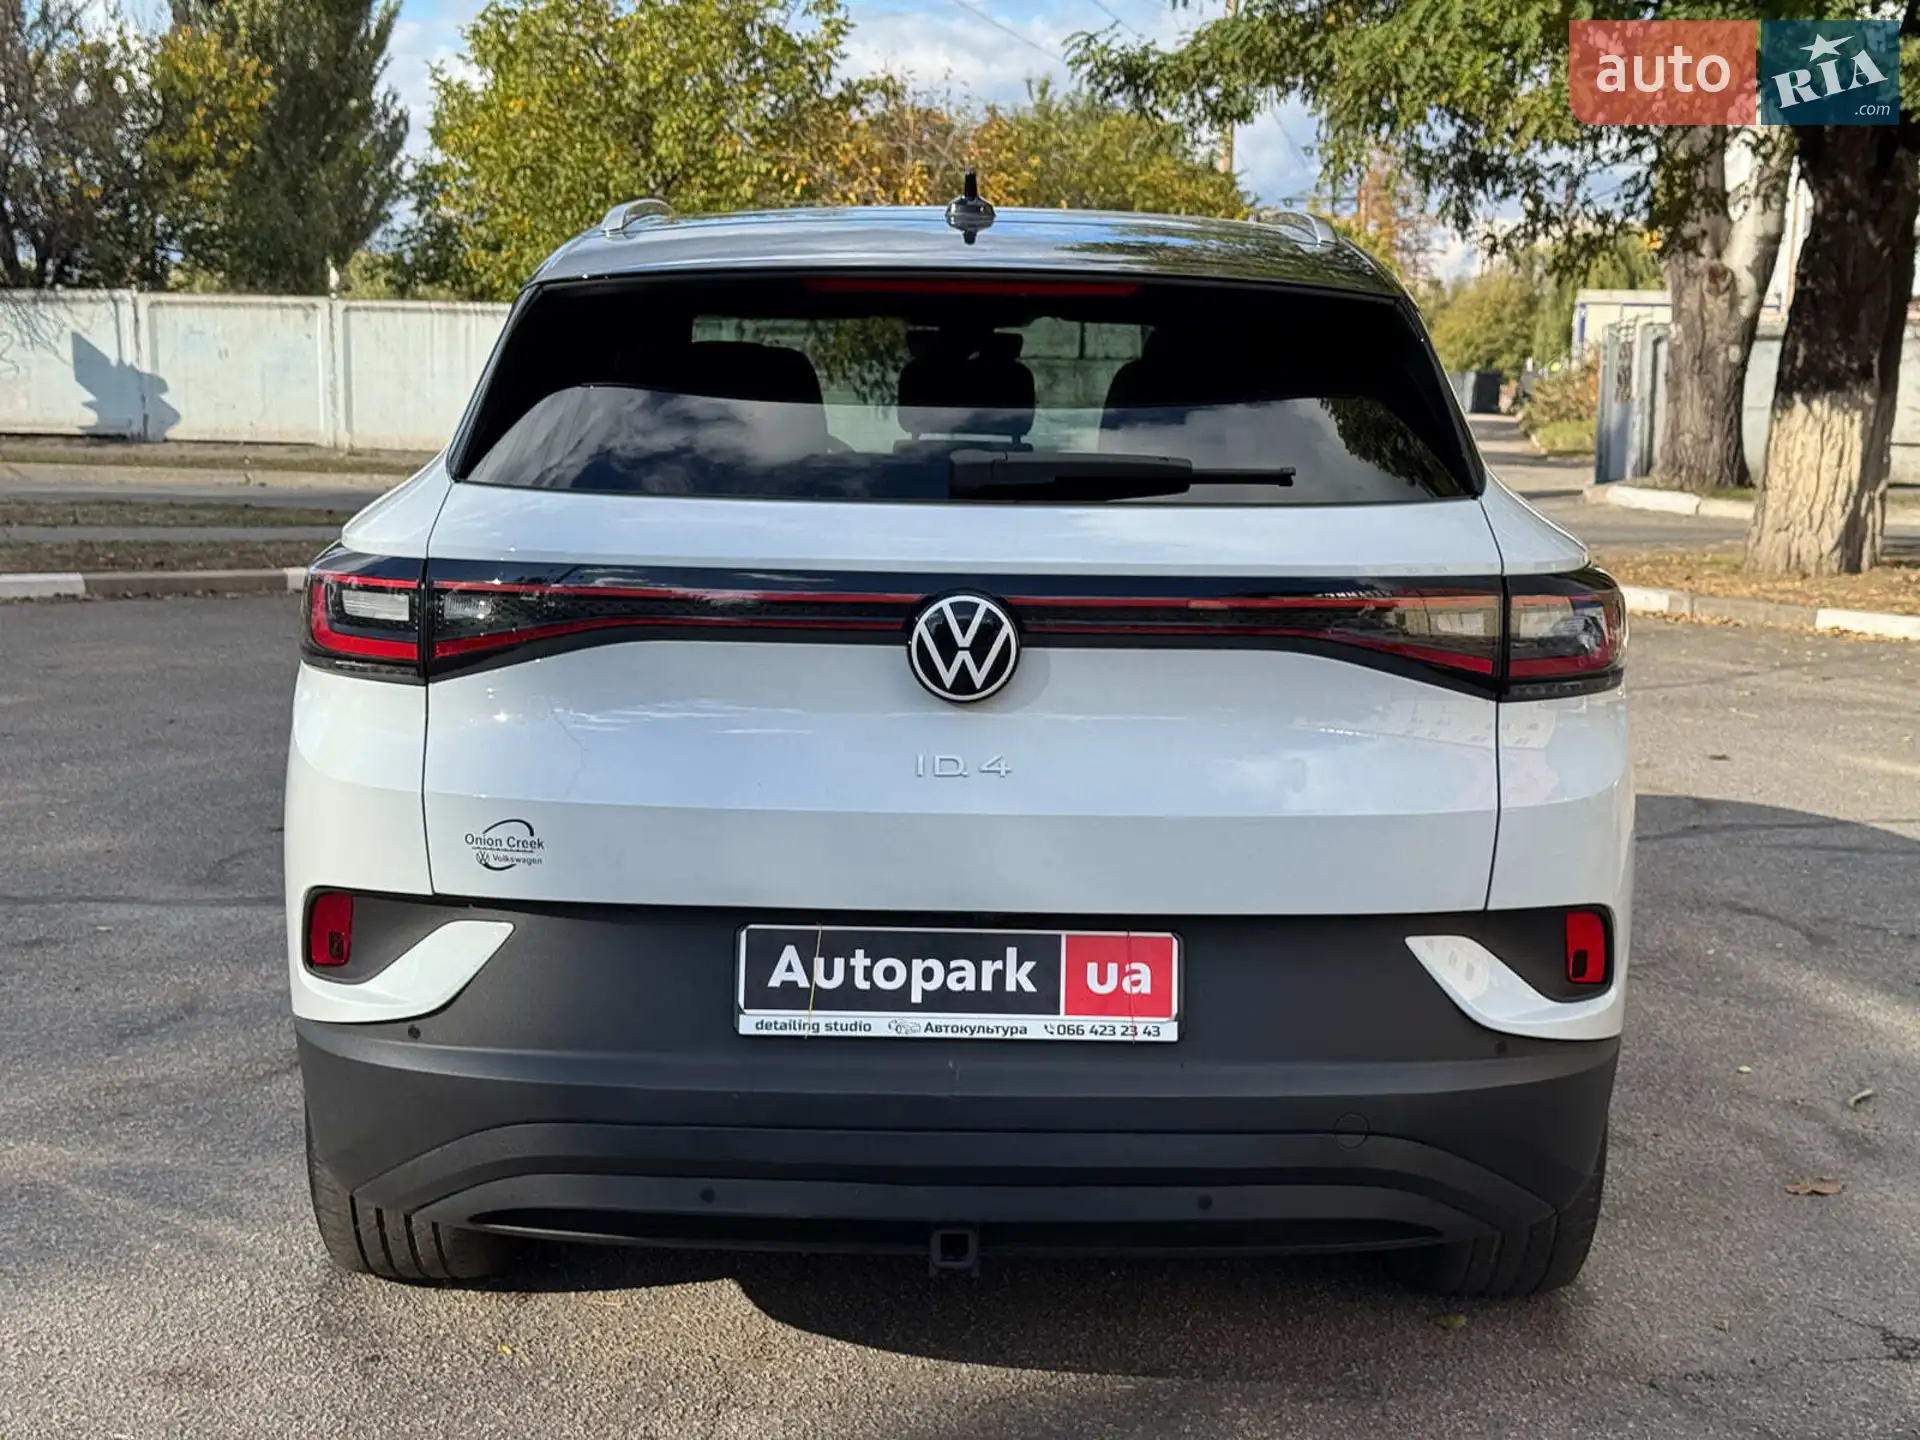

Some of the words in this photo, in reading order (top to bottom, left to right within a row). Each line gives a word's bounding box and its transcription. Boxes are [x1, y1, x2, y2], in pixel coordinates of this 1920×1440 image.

[464, 833, 503, 847] Onion
[507, 836, 545, 850] Creek
[767, 944, 1038, 1003] Autopark
[1086, 960, 1152, 995] ua
[755, 1018, 821, 1033] detailing
[824, 1020, 872, 1032] studio
[923, 1021, 1028, 1037] Автокультура
[1056, 1024, 1085, 1036] 066
[1089, 1024, 1116, 1037] 423
[1120, 1025, 1138, 1037] 23
[1142, 1025, 1161, 1038] 43
